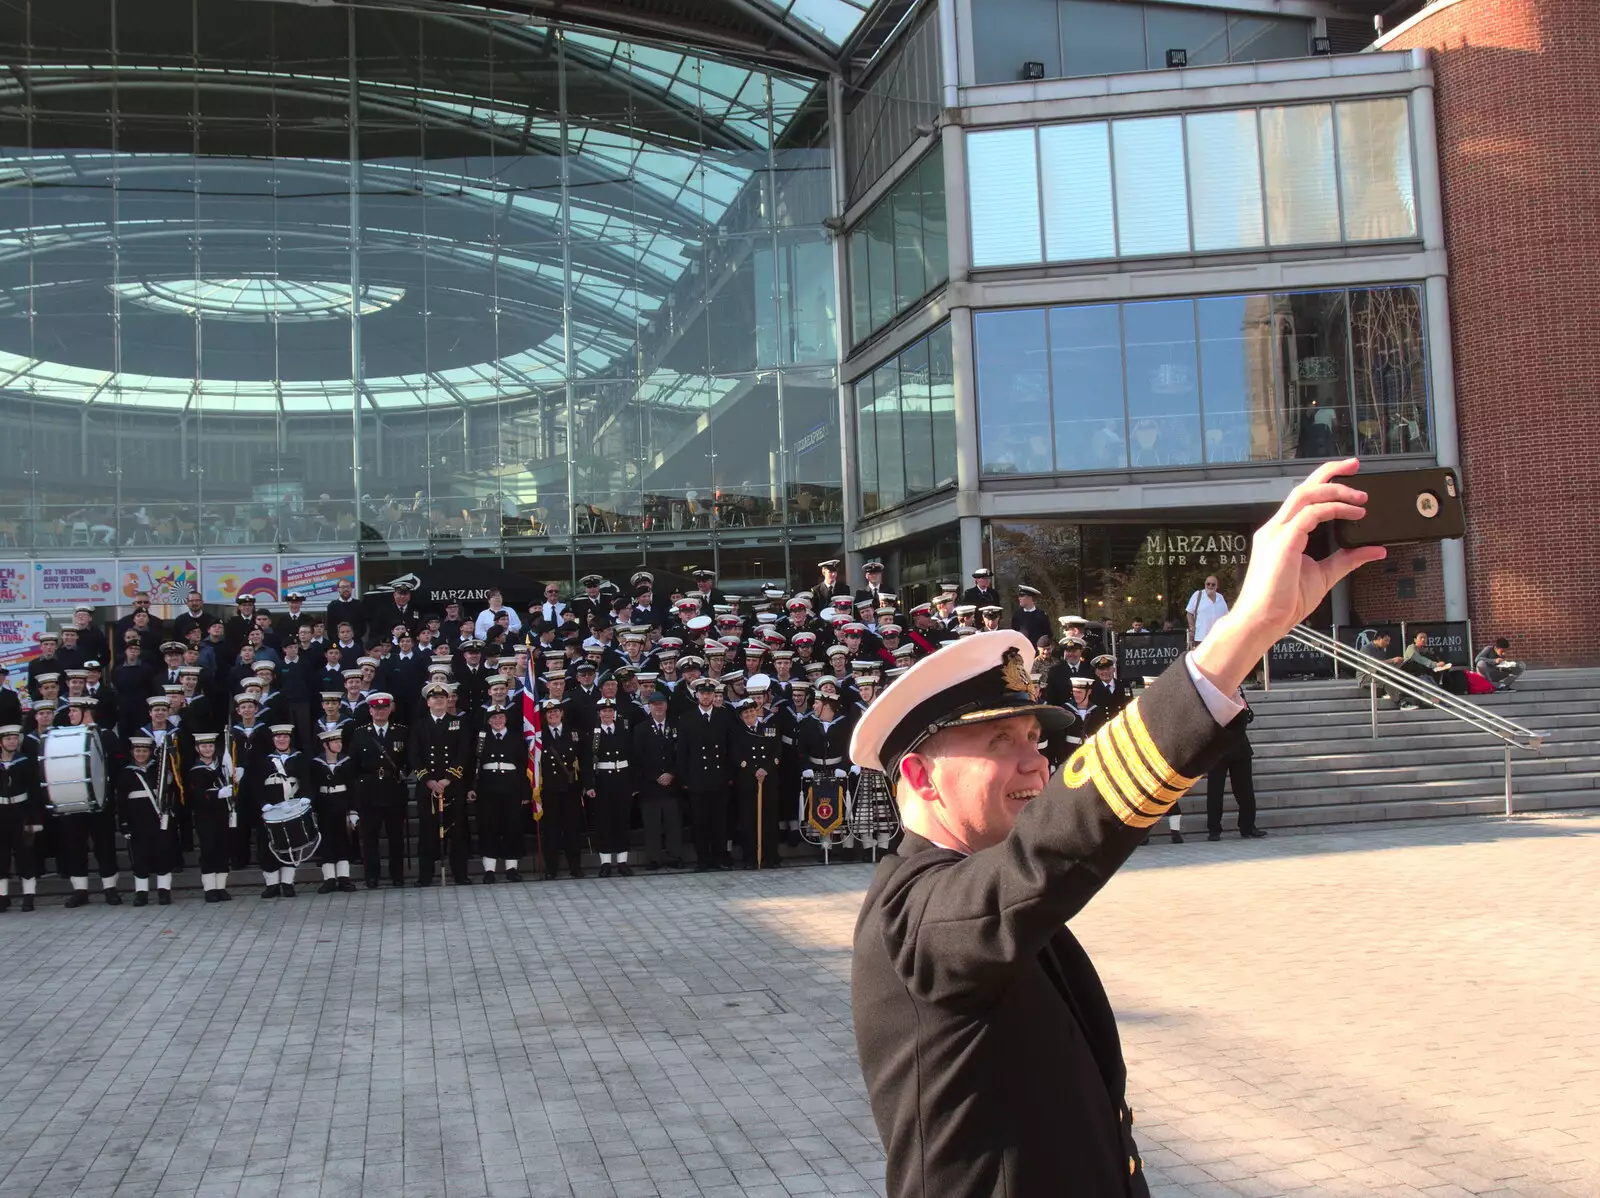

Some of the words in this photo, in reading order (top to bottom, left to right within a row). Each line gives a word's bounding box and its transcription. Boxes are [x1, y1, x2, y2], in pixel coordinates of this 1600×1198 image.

[1146, 535, 1247, 553] MARZANO
[1146, 555, 1187, 566] CAFE
[1199, 555, 1207, 565] &
[1220, 554, 1248, 565] BAR
[70, 567, 96, 575] FORUM
[60, 575, 85, 583] OTHER
[43, 582, 59, 590] CITY
[61, 582, 89, 590] VENUES
[1125, 647, 1178, 659] MARZANO
